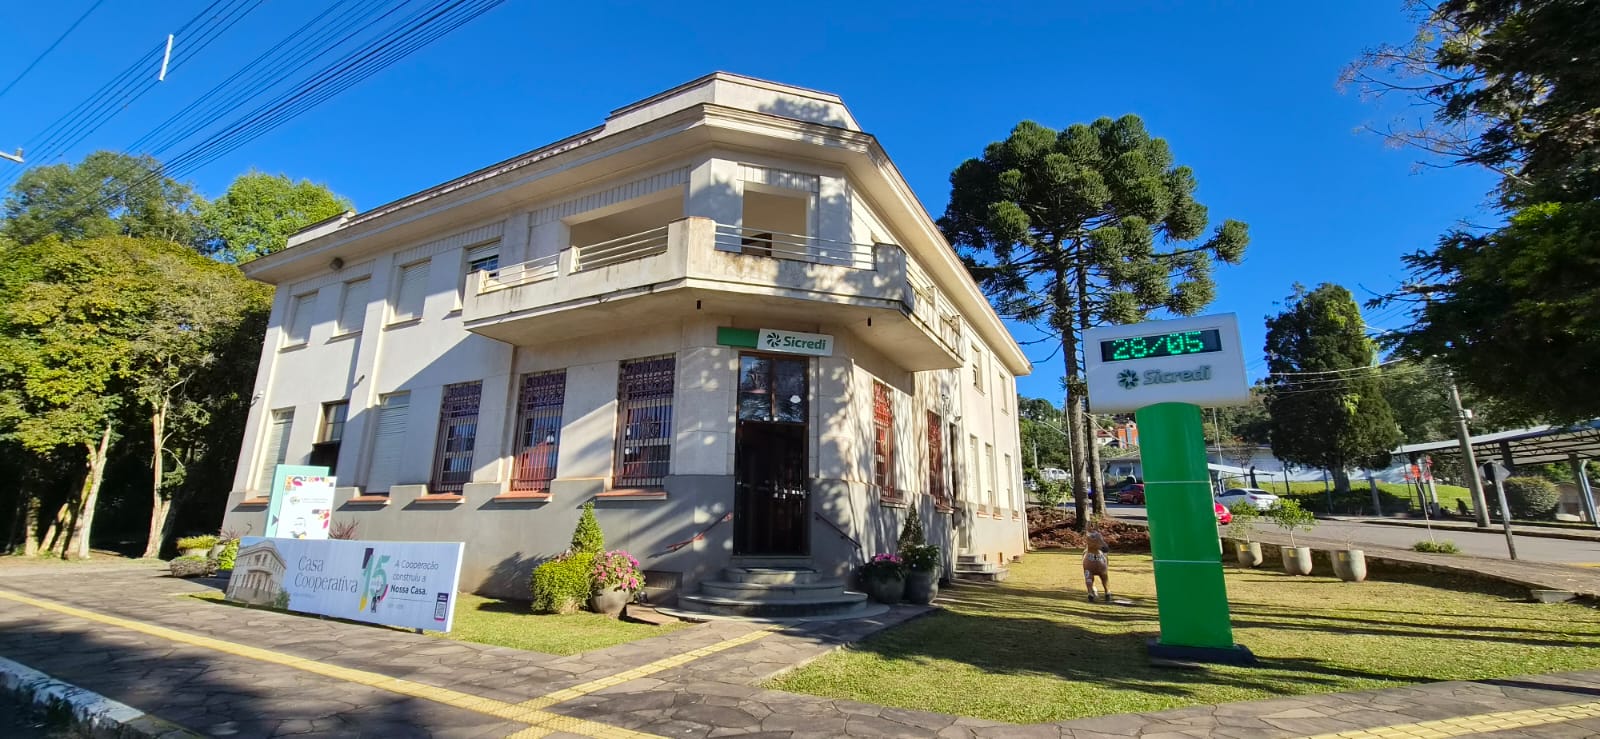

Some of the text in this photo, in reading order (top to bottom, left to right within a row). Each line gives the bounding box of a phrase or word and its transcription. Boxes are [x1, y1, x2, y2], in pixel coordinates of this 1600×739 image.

[783, 336, 827, 350] Sicredi
[1113, 330, 1203, 360] 28/05
[1143, 365, 1211, 386] Sicredi
[298, 556, 324, 572] Casa
[394, 560, 439, 570] A Cooperação
[294, 573, 359, 593] Cooperativa
[393, 573, 421, 582] construiu
[391, 584, 408, 594] Nossa
